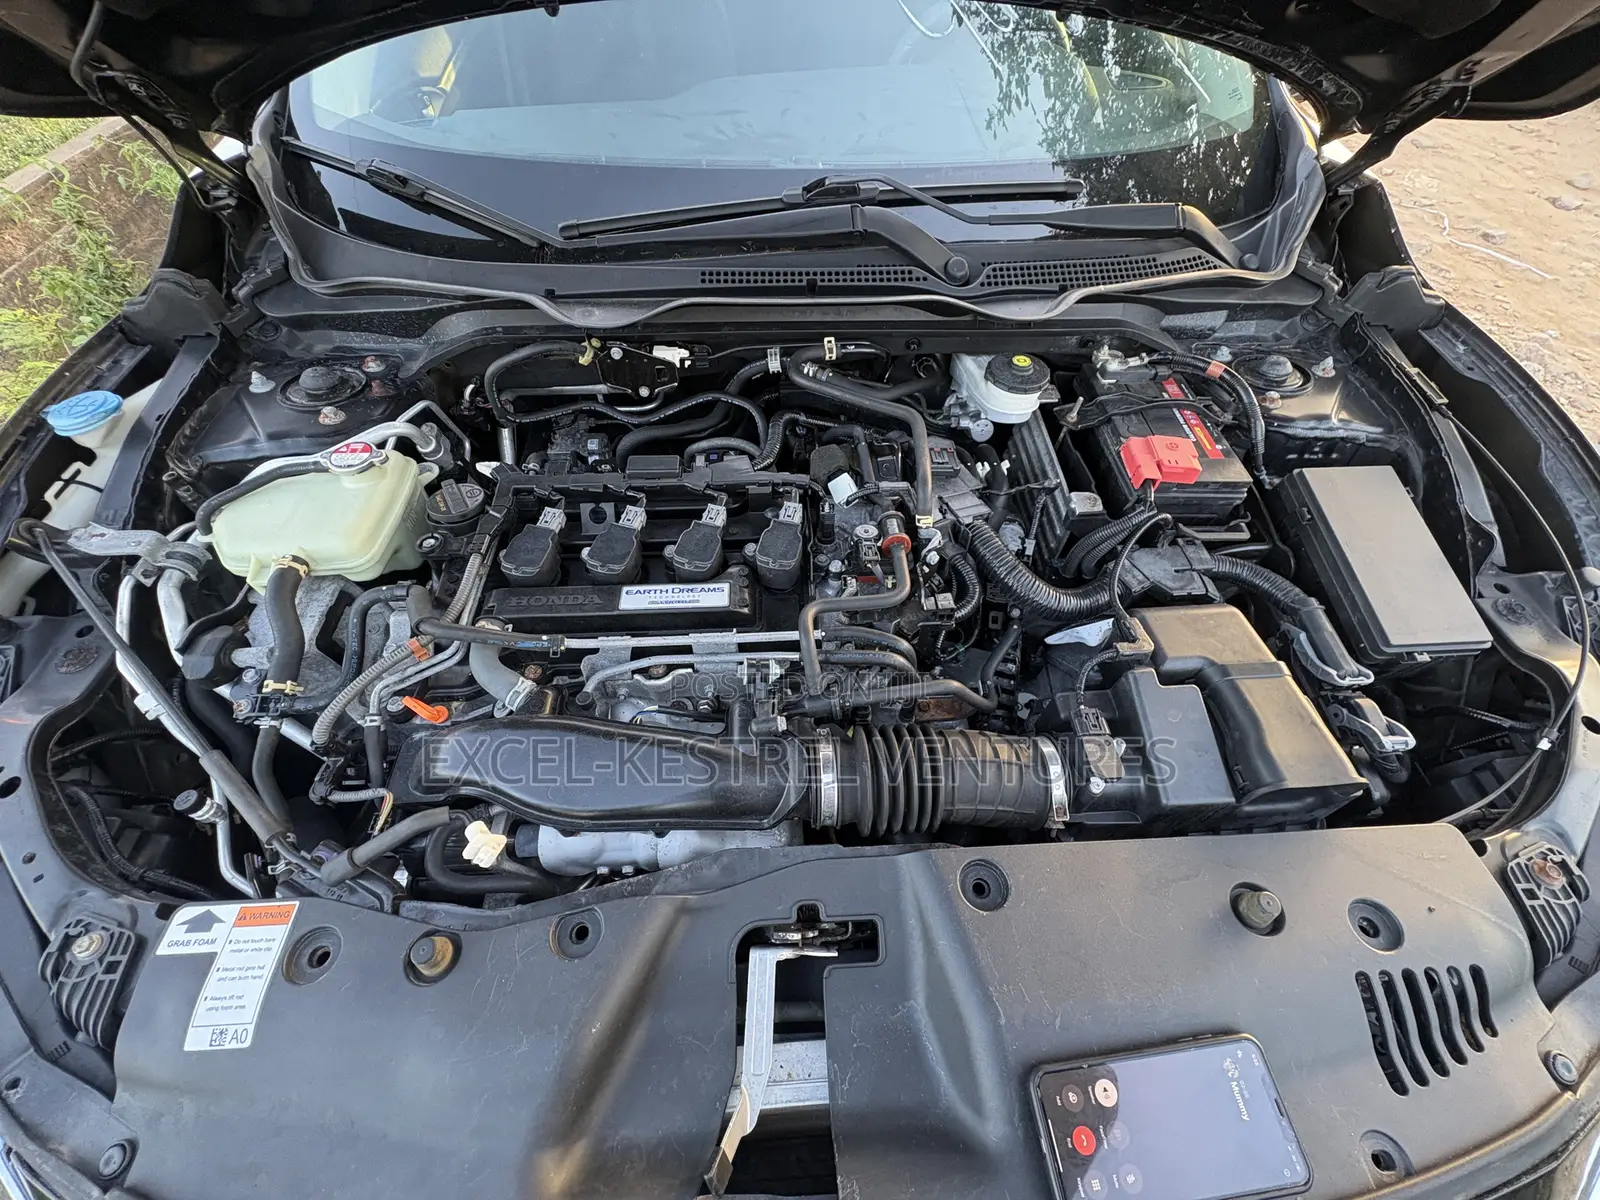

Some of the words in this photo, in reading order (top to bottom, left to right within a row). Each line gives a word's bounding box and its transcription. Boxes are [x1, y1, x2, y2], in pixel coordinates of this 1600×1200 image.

[507, 594, 603, 606] HONDA
[249, 910, 291, 920] WARNING
[167, 939, 191, 948] GRAB
[192, 937, 218, 946] FOAM
[228, 1028, 249, 1045] A0
[1230, 1081, 1250, 1121] Mummy
